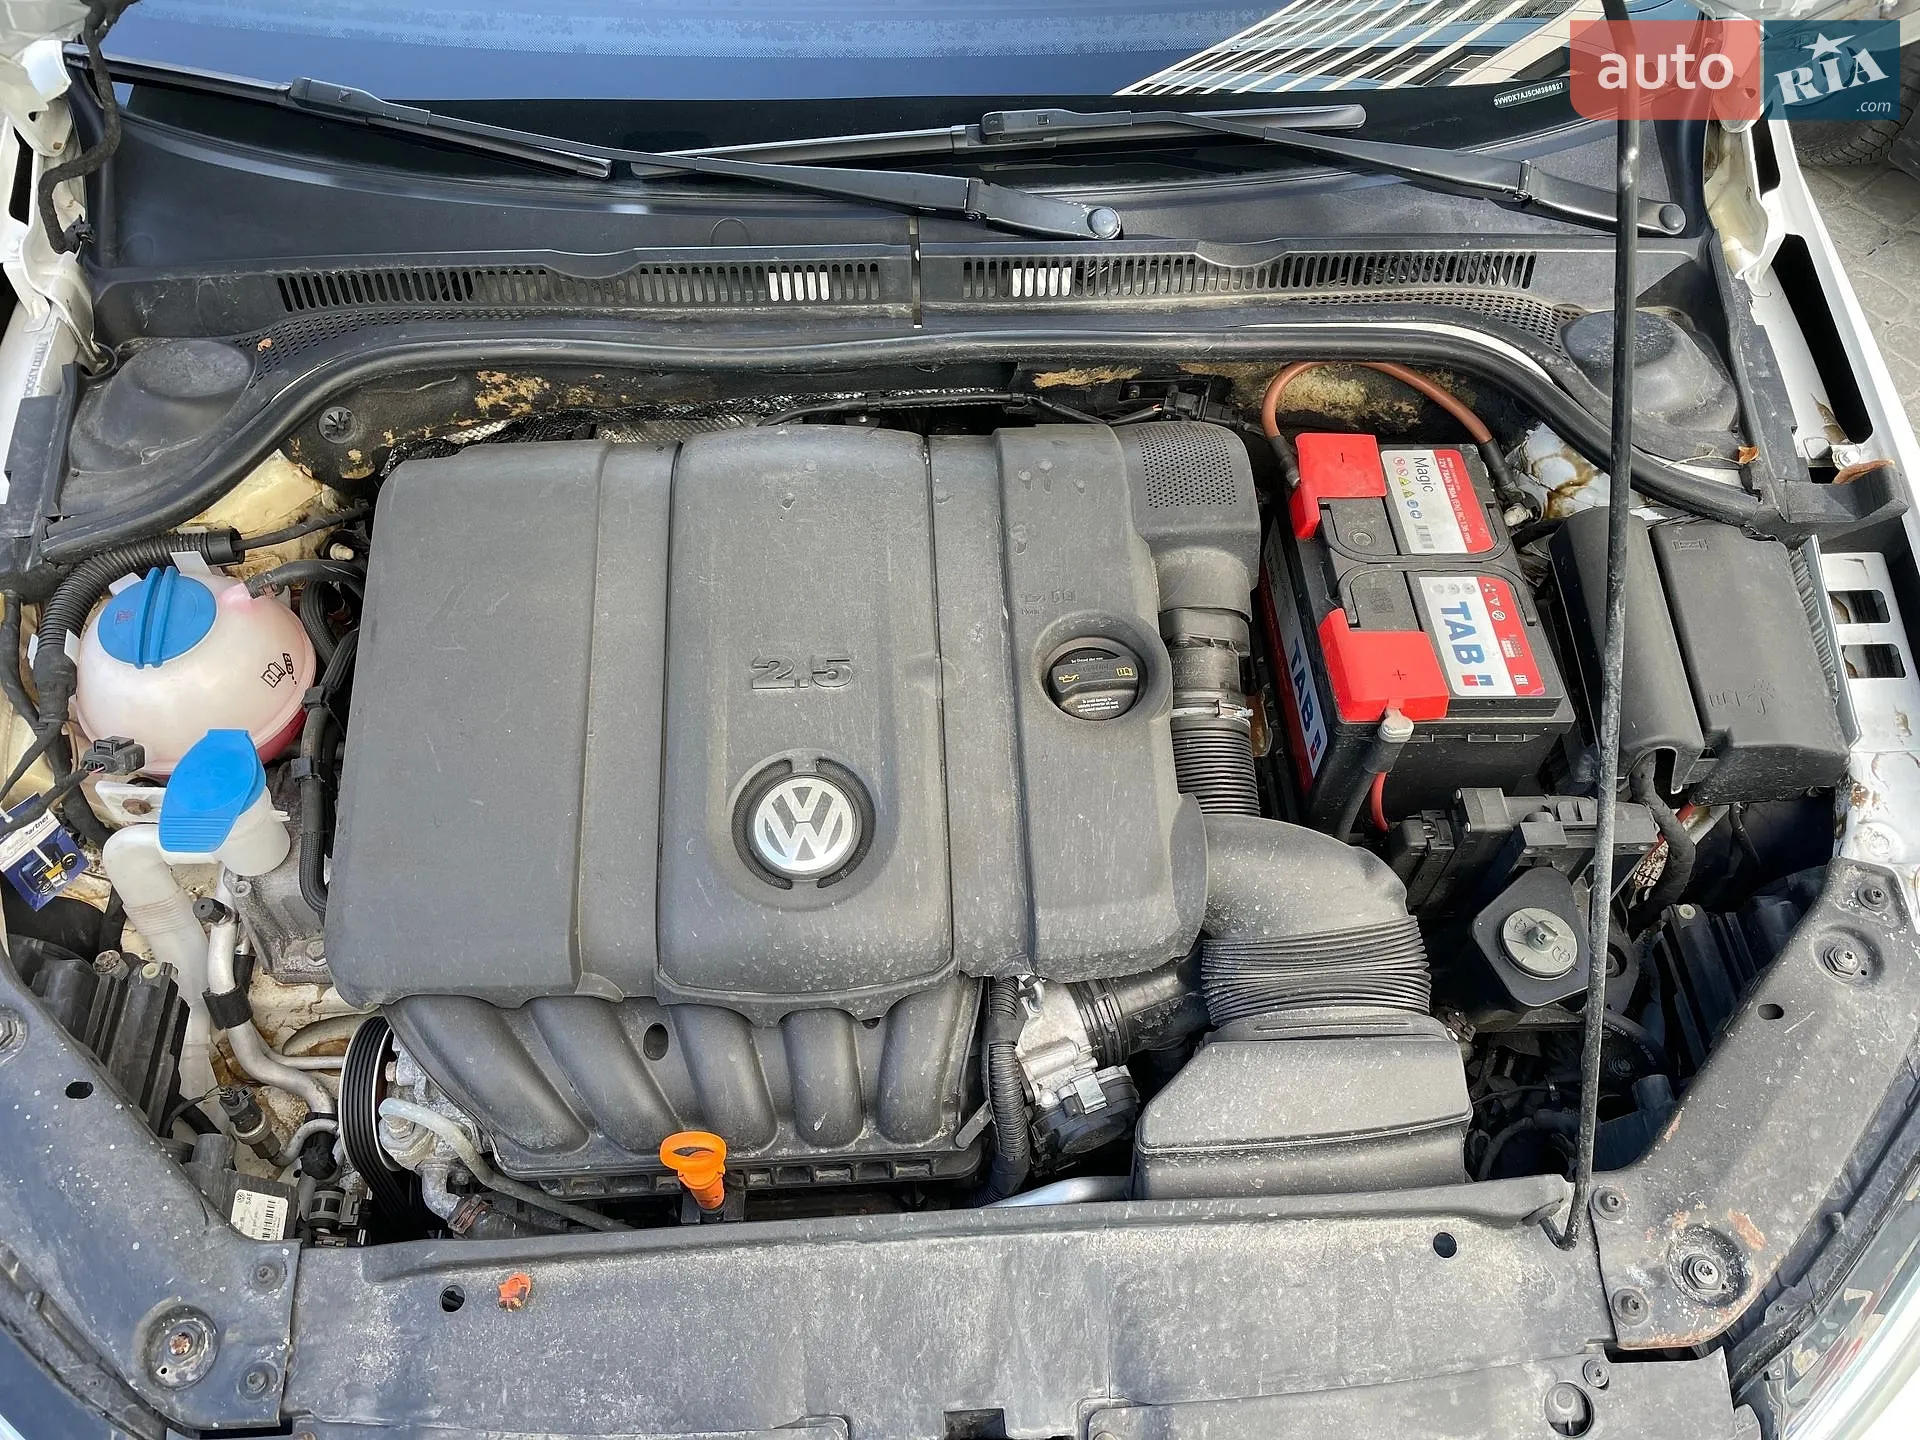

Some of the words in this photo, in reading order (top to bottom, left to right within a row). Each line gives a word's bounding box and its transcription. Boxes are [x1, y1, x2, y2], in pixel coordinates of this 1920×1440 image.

[1413, 457, 1433, 492] Magic
[1440, 600, 1486, 666] TAB
[751, 656, 852, 690] 2.5
[1291, 638, 1314, 732] TAB
